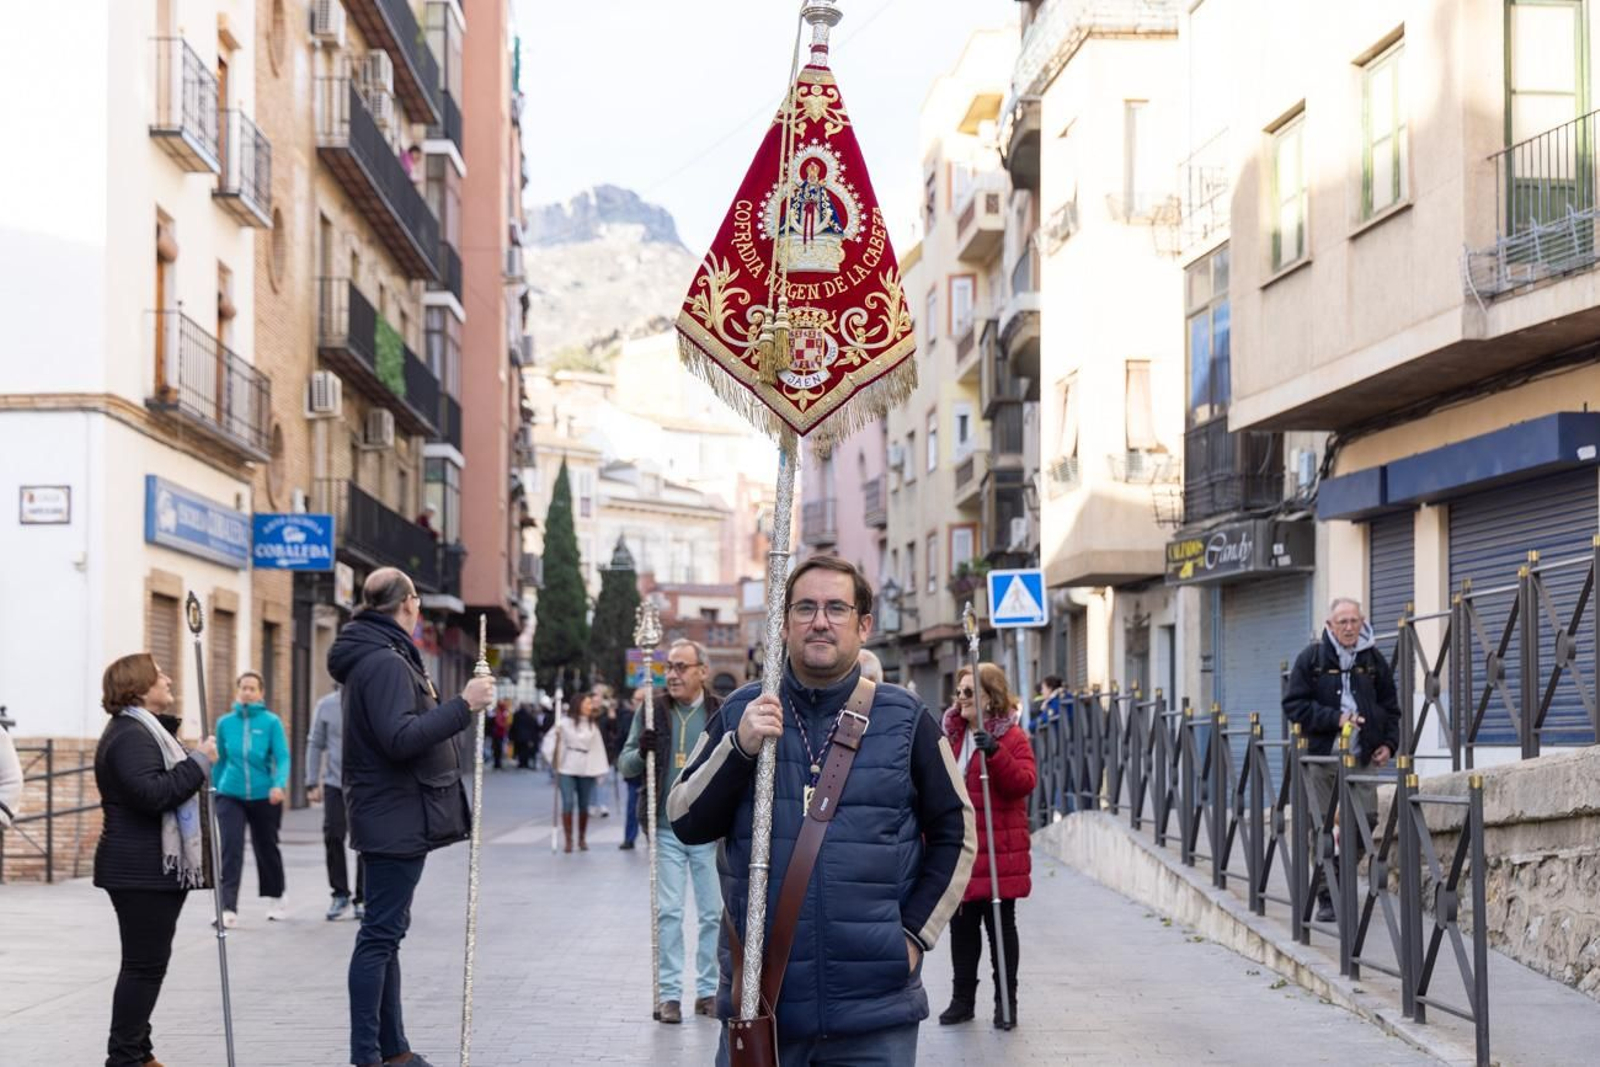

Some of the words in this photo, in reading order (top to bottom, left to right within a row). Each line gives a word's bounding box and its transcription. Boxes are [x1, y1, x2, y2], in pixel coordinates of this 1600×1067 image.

[731, 200, 765, 279] COFRADIA
[823, 276, 848, 299] DE
[846, 264, 871, 286] LA
[787, 374, 821, 387] JAEN
[254, 543, 330, 559] COBALEDA
